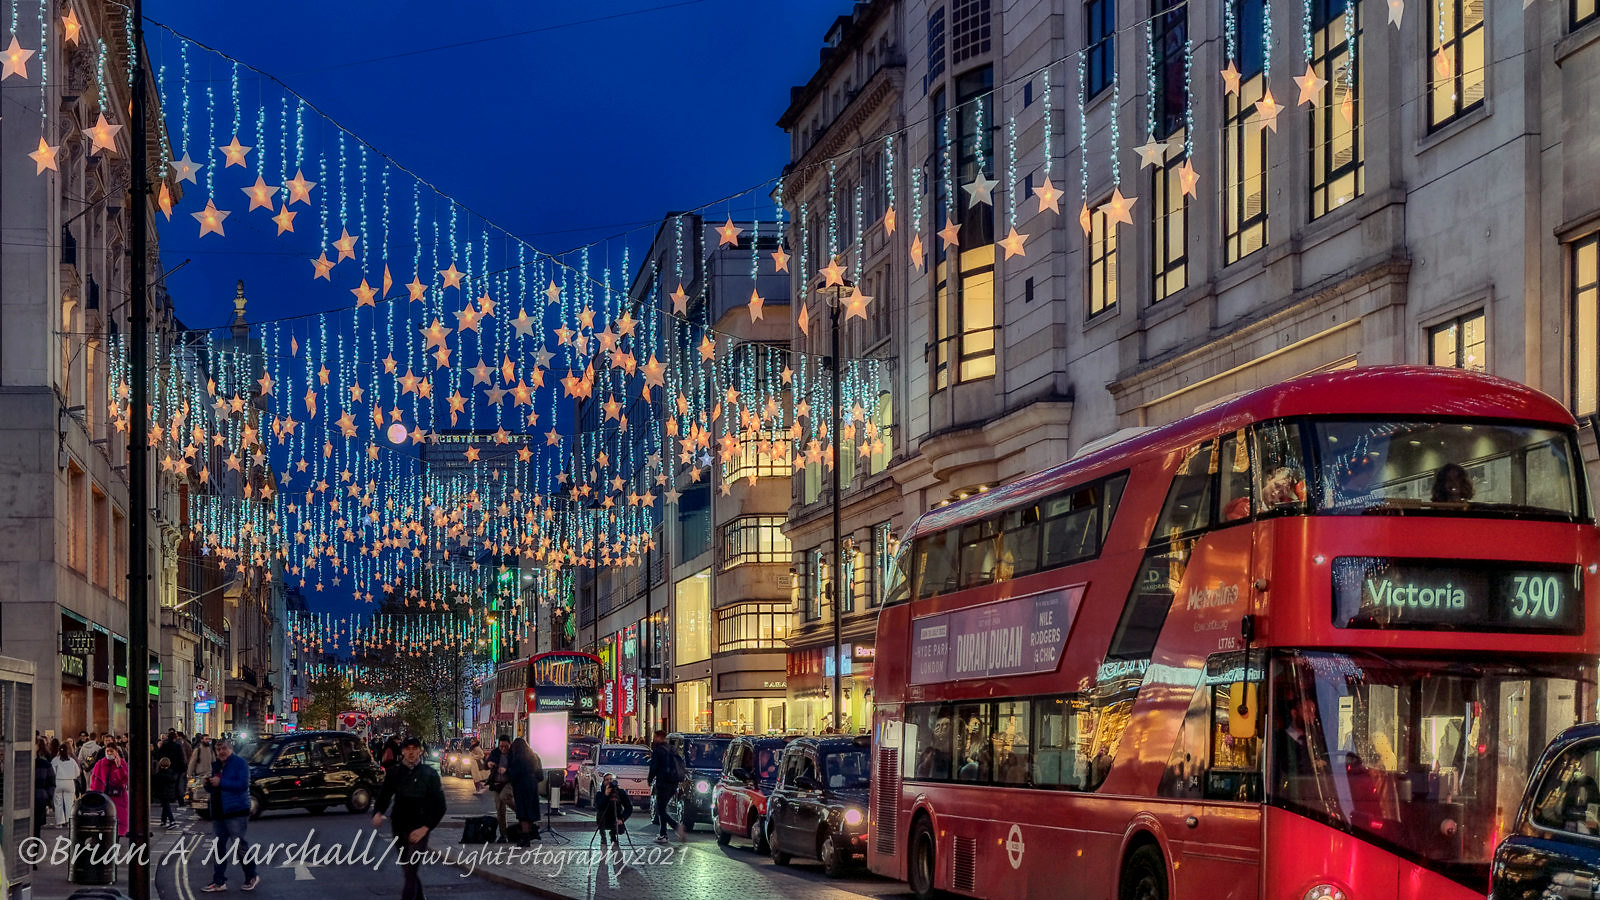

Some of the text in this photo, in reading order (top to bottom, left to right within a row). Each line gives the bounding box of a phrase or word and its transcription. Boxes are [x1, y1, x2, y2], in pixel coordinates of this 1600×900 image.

[439, 435, 519, 443] CENTRE PNT
[1367, 576, 1560, 617] Victoria 390
[1039, 610, 1054, 626] NILE
[68, 638, 96, 648] UTFIT
[1030, 627, 1061, 646] RODGERS
[1218, 637, 1236, 650] LT765
[956, 625, 1023, 673] DURAN DURAN
[1039, 646, 1056, 663] CHIC
[920, 660, 945, 674] LONDON
[581, 697, 593, 708] 98
